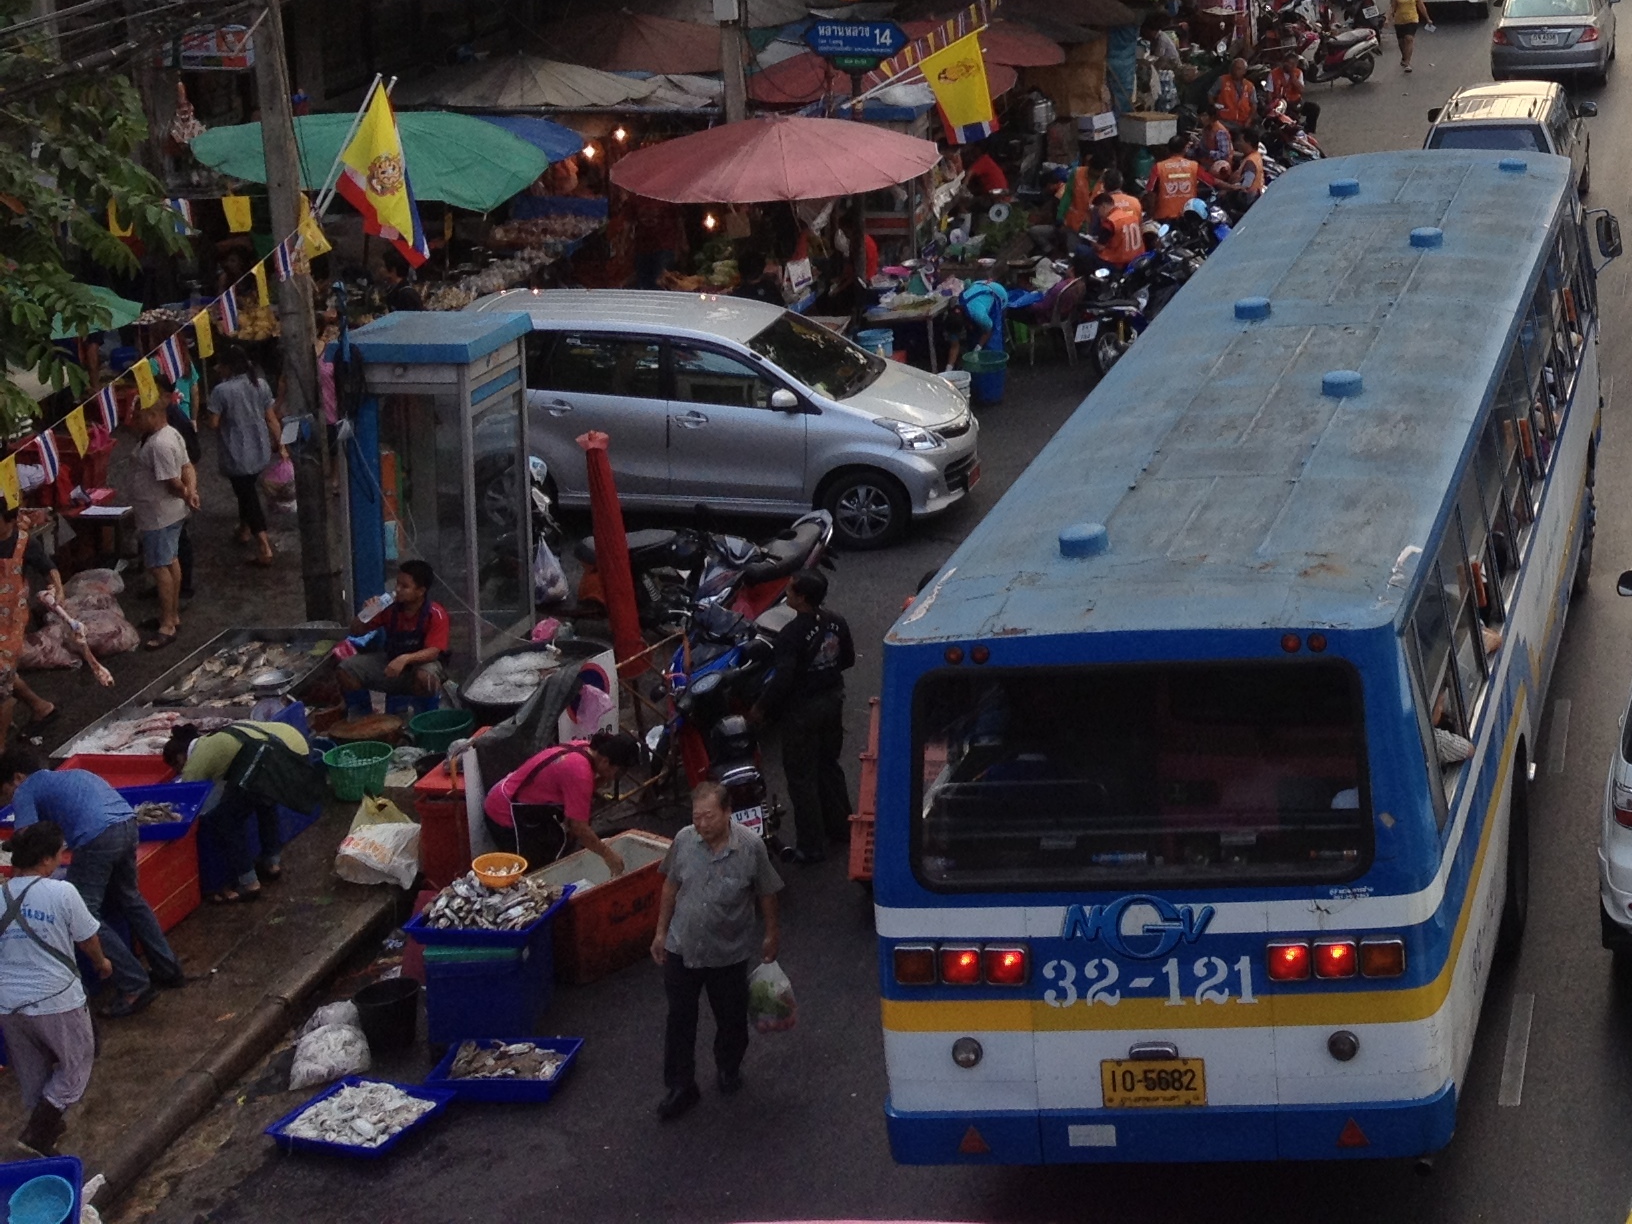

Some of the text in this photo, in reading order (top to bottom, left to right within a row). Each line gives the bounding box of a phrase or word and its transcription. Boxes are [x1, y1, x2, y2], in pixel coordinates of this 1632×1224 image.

[818, 25, 892, 46] หลานหลวง 14
[1122, 222, 1141, 252] 10
[1062, 893, 1216, 960] NGV
[1042, 955, 1259, 1008] 32-121
[1111, 1068, 1198, 1093] 10-5682
